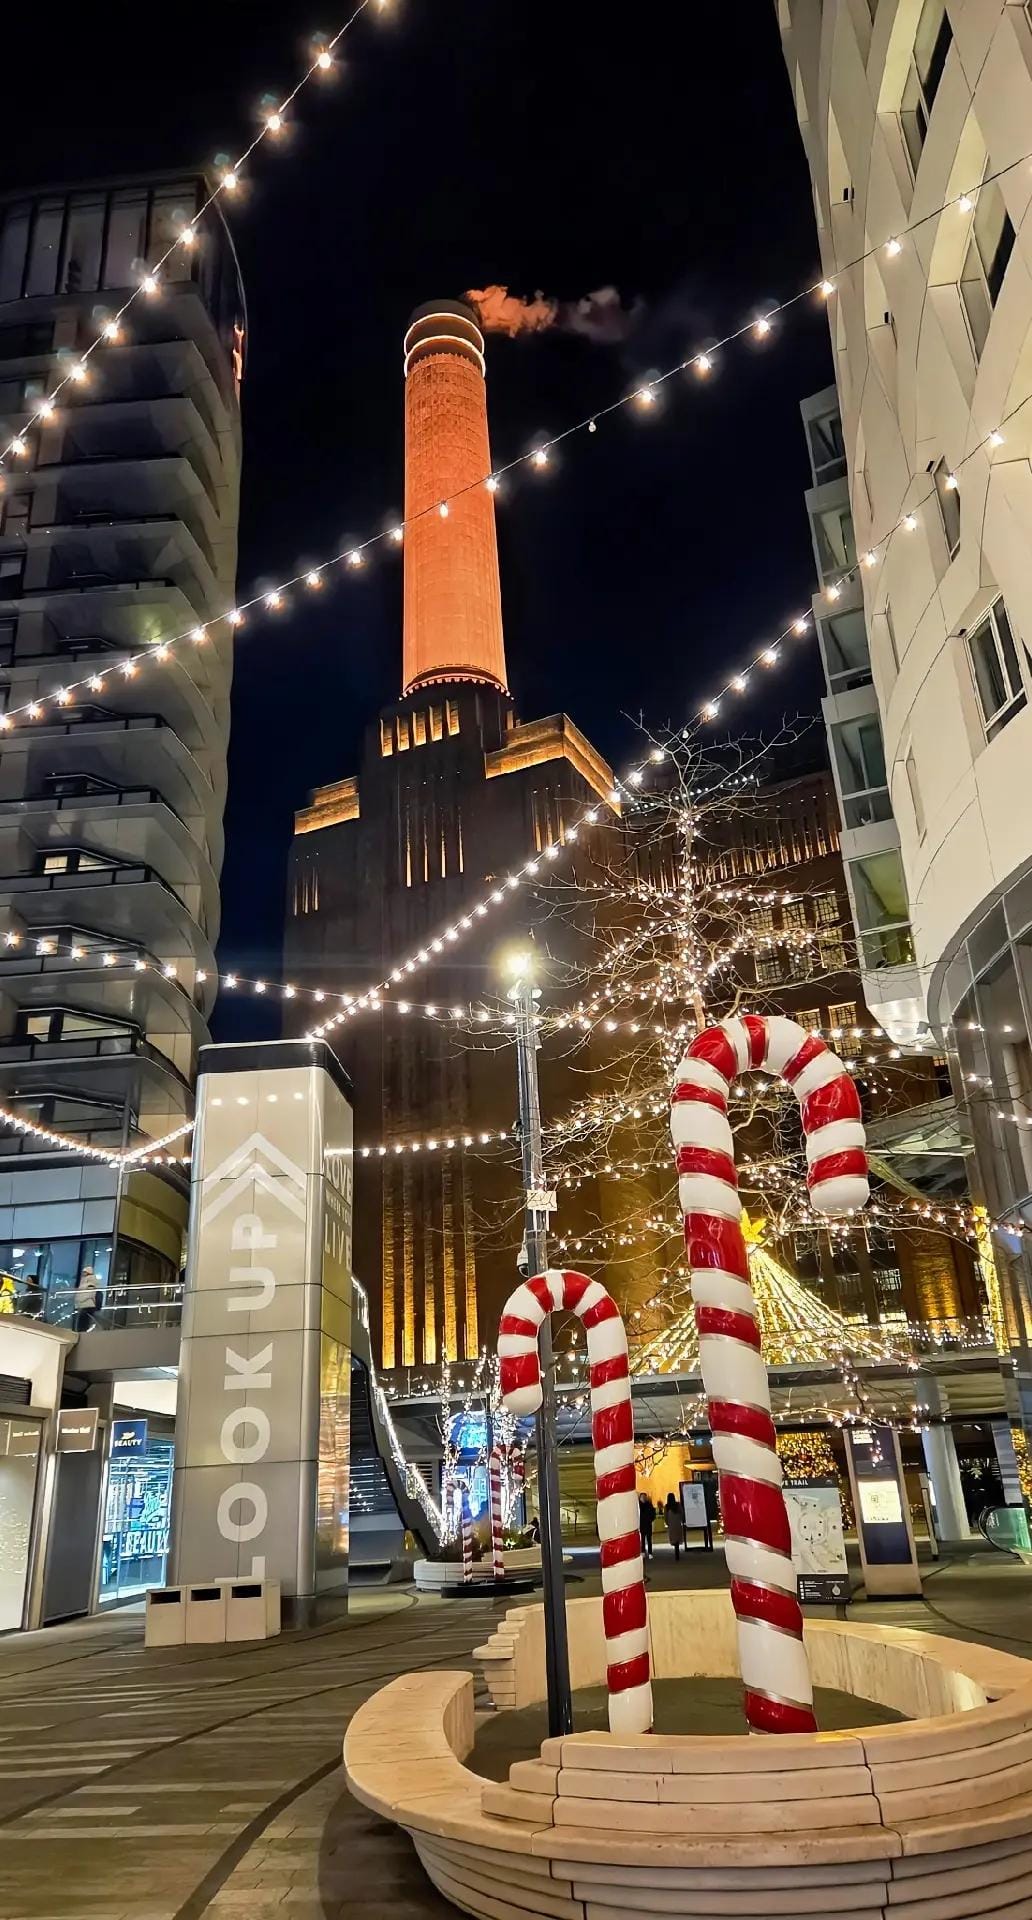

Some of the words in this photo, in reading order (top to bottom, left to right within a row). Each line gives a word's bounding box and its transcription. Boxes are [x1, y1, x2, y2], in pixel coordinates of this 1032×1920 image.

[325, 1147, 352, 1207] LOVE
[227, 1213, 277, 1312] UP
[324, 1213, 352, 1271] LIVE
[114, 1438, 143, 1448] BEAUTY
[214, 1342, 273, 1585] LOOK
